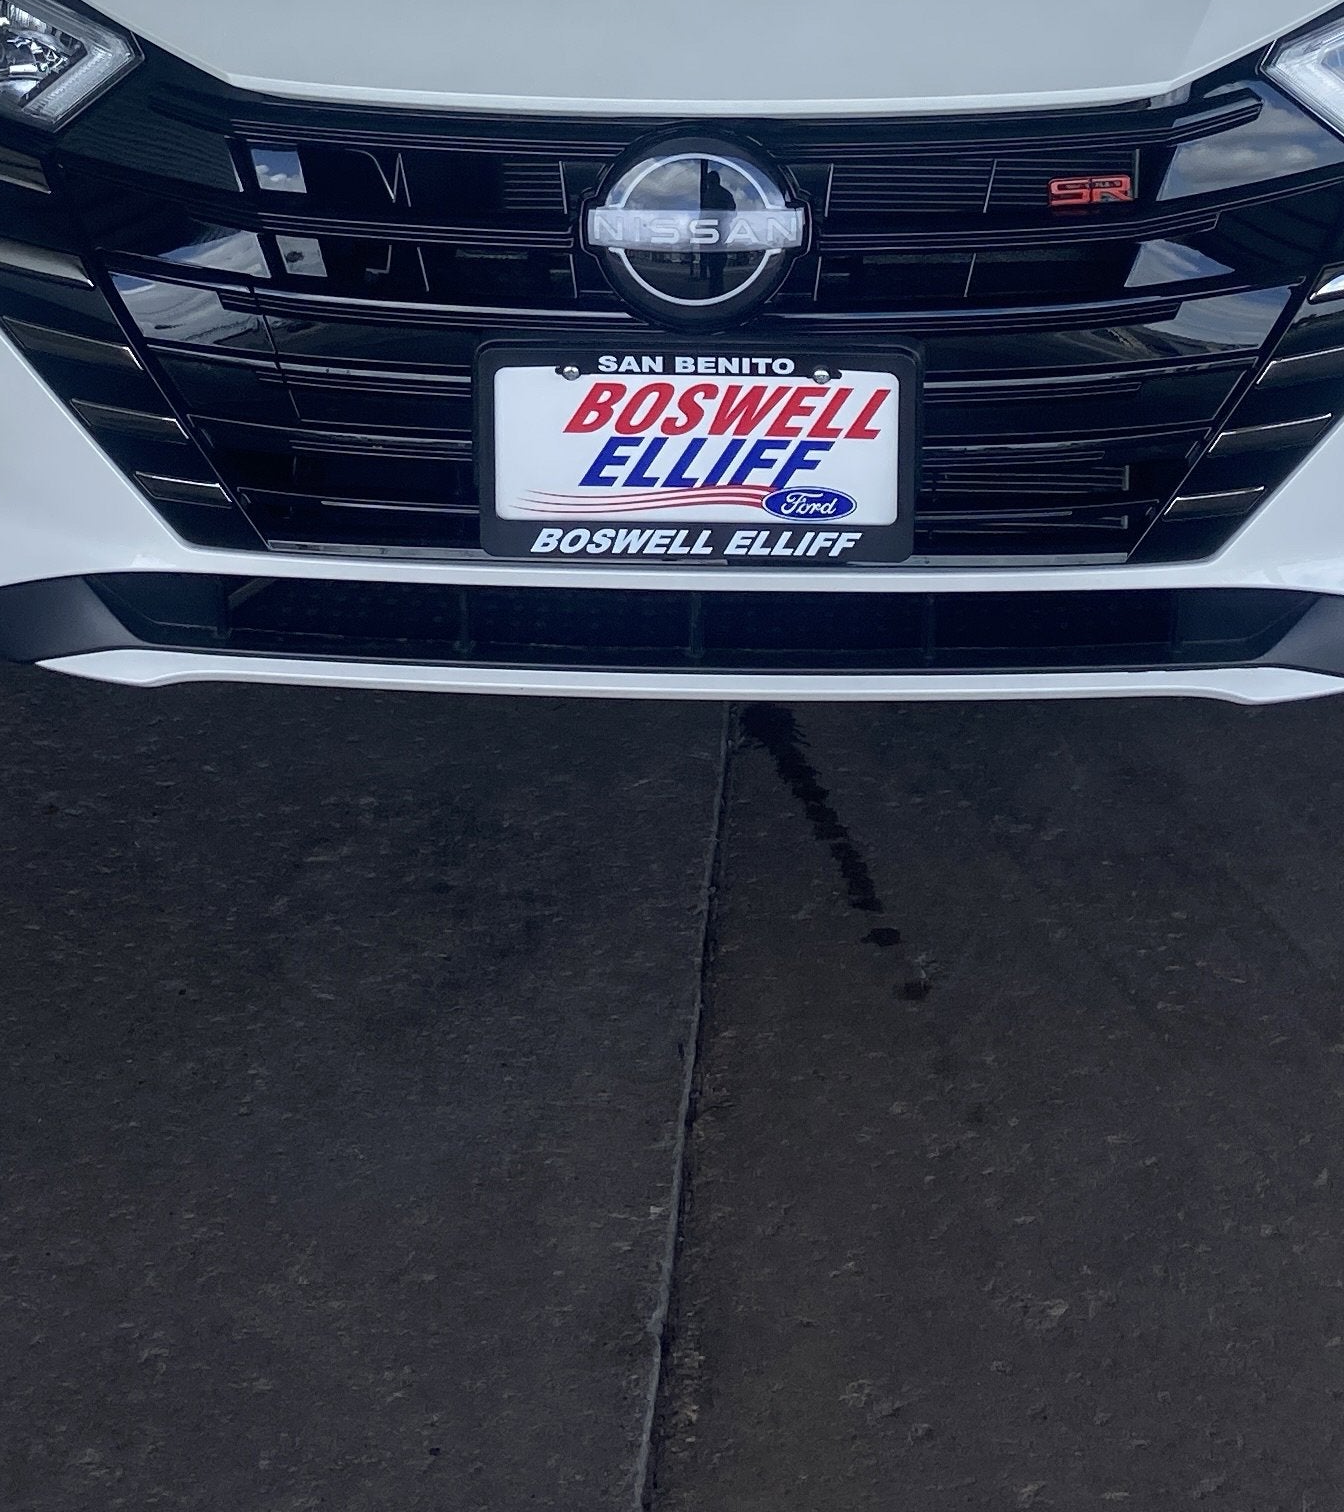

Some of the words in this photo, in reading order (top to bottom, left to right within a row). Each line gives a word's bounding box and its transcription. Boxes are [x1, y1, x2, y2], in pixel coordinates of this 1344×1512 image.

[1049, 175, 1133, 206] SR
[594, 215, 797, 245] NISSAN
[597, 355, 663, 373] SAN
[675, 356, 795, 375] BENITO
[563, 382, 891, 440] BOSWELL
[578, 437, 836, 489] ELLIFF
[780, 492, 838, 515] Ford
[530, 528, 714, 555] BOSWELL
[723, 531, 863, 557] ELLIFF
